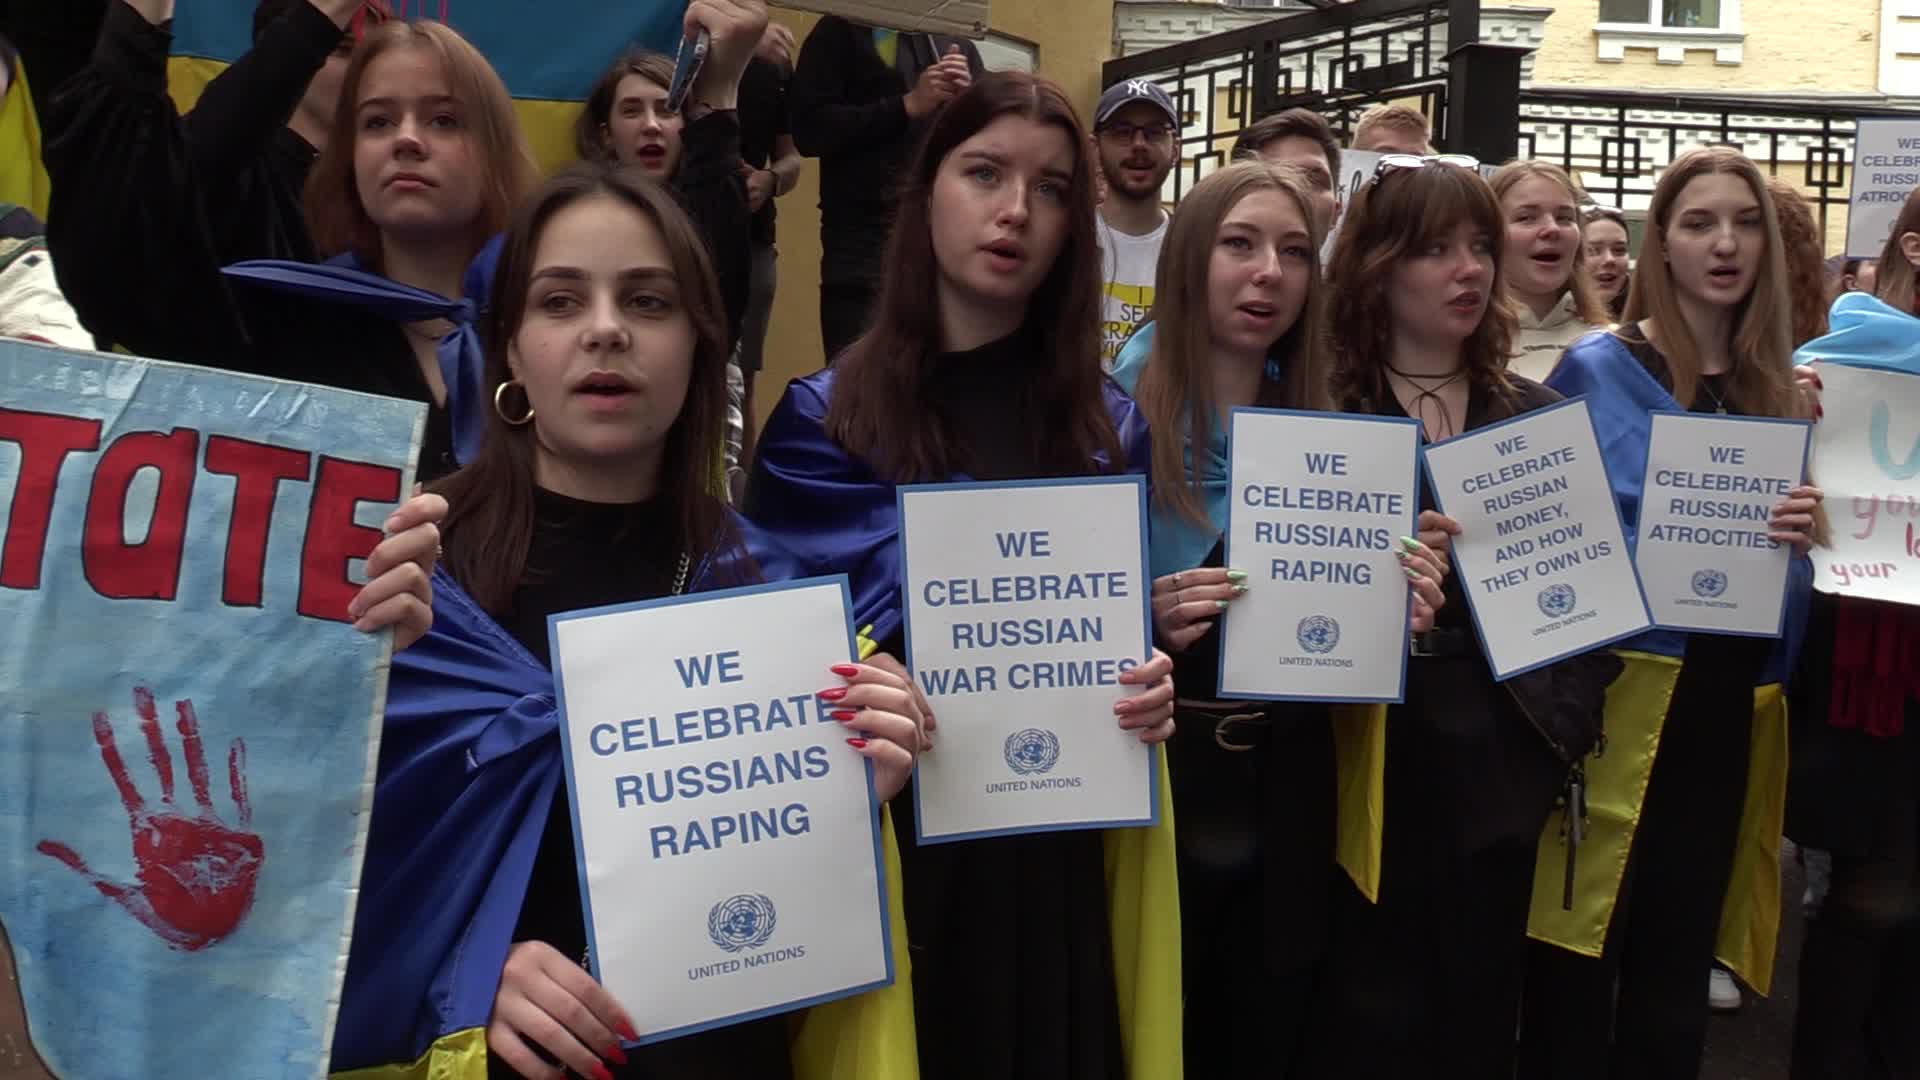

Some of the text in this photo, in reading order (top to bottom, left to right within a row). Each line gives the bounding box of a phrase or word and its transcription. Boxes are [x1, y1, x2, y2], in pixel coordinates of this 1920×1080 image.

[1896, 138, 1920, 149] WE
[1494, 435, 1528, 457] WE
[1709, 446, 1745, 465] WE
[1304, 452, 1348, 476] WE
[1462, 446, 1576, 495] CELEBRATE
[1483, 475, 1569, 515] RUSSIAN
[1655, 470, 1792, 496] CELEBRATE
[1243, 485, 1403, 515] CELEBRATE
[1669, 498, 1768, 521] RUSSIAN
[1496, 502, 1569, 537] MONEY,
[995, 531, 1051, 558] WE
[1255, 521, 1390, 550] RUSSIANS
[1494, 523, 1584, 564] AND HOW
[1271, 558, 1372, 585] RAPING
[1480, 540, 1612, 594] THEY OWN US
[923, 572, 1129, 607] CELEBRATE
[952, 617, 1103, 649] RUSSIAN
[674, 650, 744, 689] WE
[1279, 656, 1354, 668] UNITED NATIONS
[919, 666, 997, 696] WAR
[615, 746, 831, 809] RUSSIANS
[985, 776, 1082, 794] UNITED NATIONS
[650, 803, 811, 859] RAPING
[688, 945, 806, 981] UNITED NATIONS
